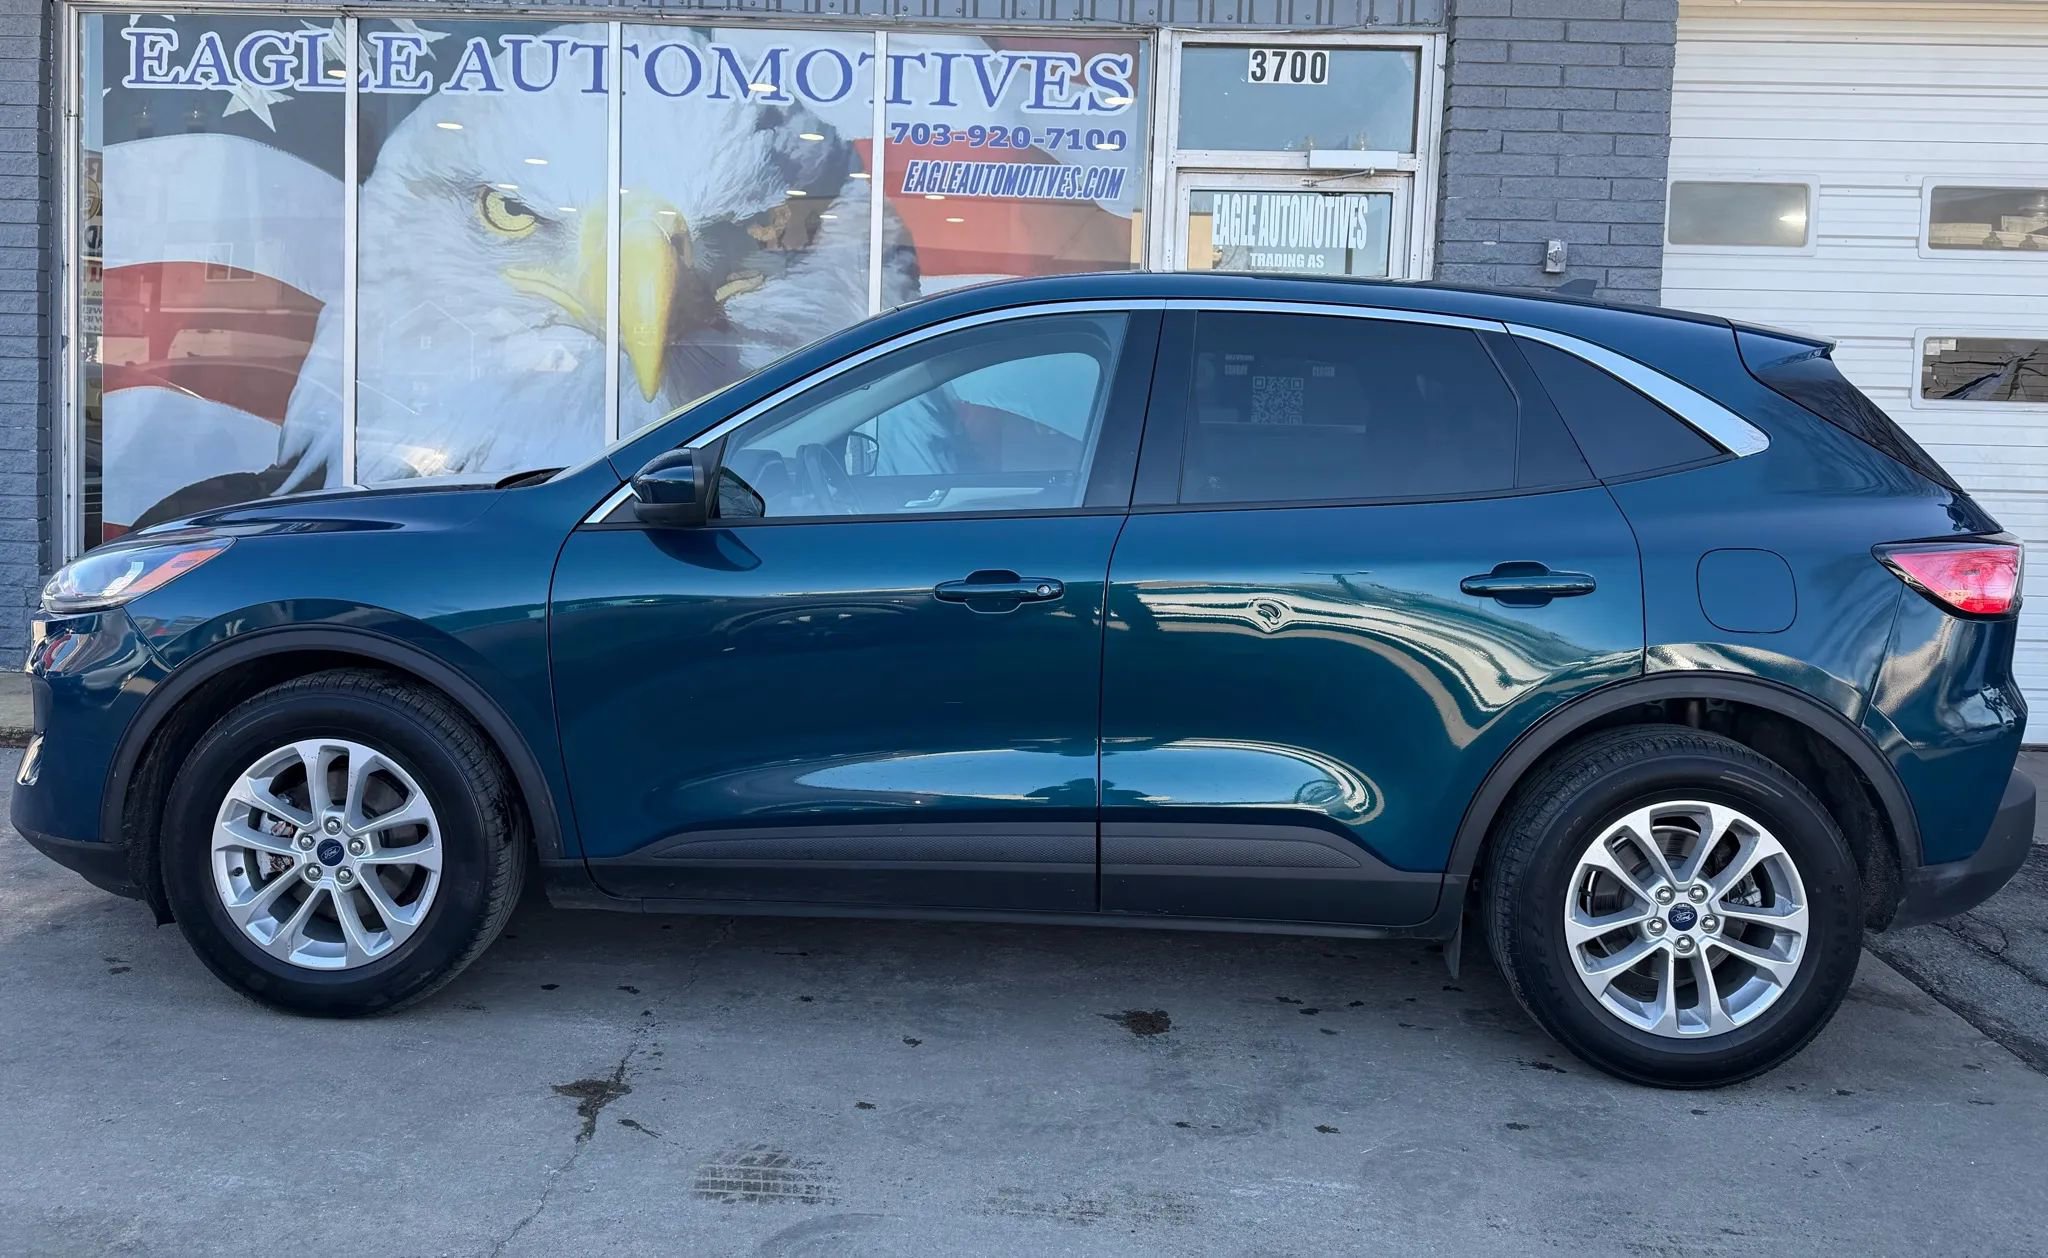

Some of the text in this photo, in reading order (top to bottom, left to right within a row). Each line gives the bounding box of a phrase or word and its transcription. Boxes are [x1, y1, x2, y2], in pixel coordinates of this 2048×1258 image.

[123, 30, 1134, 111] EAGLE AUTOMOTIVES
[1250, 49, 1327, 84] 3700
[890, 121, 1128, 152] 703-920-7100
[902, 159, 1128, 200] EAGLEAUTOMOTIVES.COM
[1212, 193, 1369, 250] EAGLE AUTOMOTIVES
[1250, 252, 1325, 268] TRADING AS
